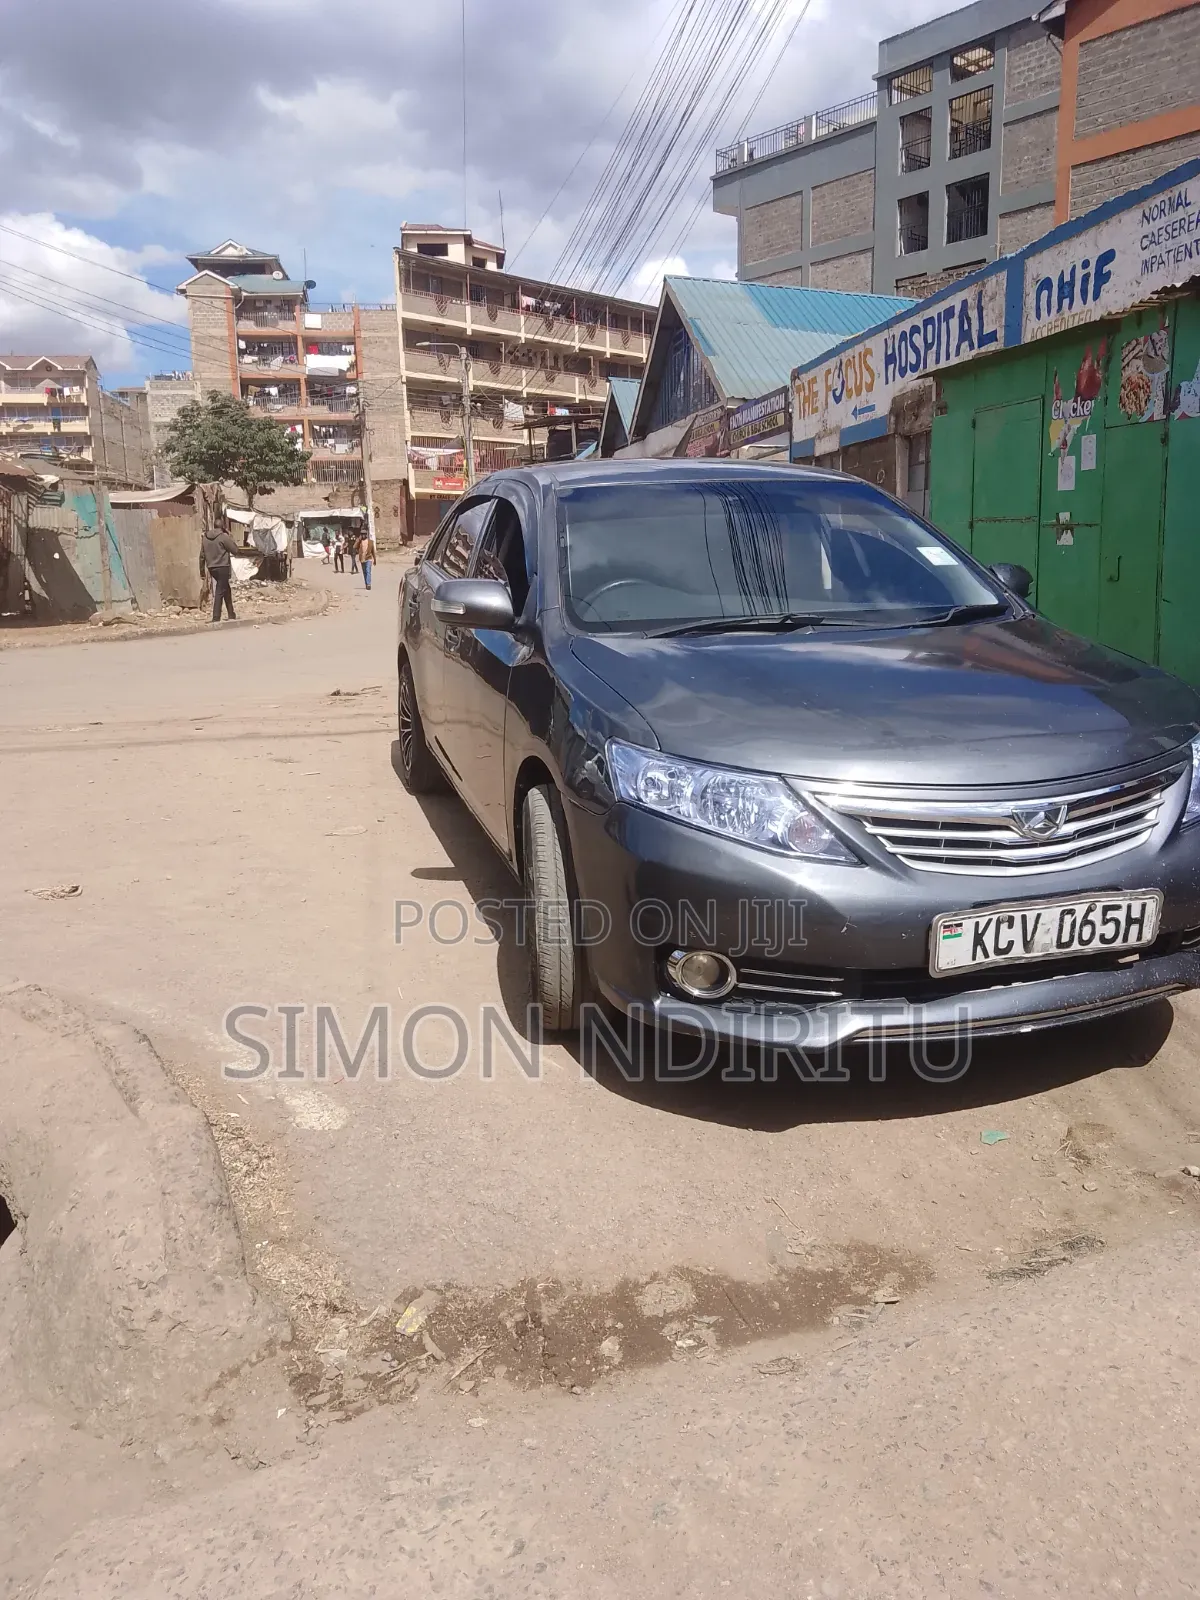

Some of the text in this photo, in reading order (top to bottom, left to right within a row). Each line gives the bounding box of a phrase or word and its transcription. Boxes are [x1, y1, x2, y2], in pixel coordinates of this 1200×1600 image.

[1141, 188, 1191, 228] NORMAL
[794, 289, 998, 421] THE FOCUS HOSPITAL
[971, 912, 1042, 961] KCV
